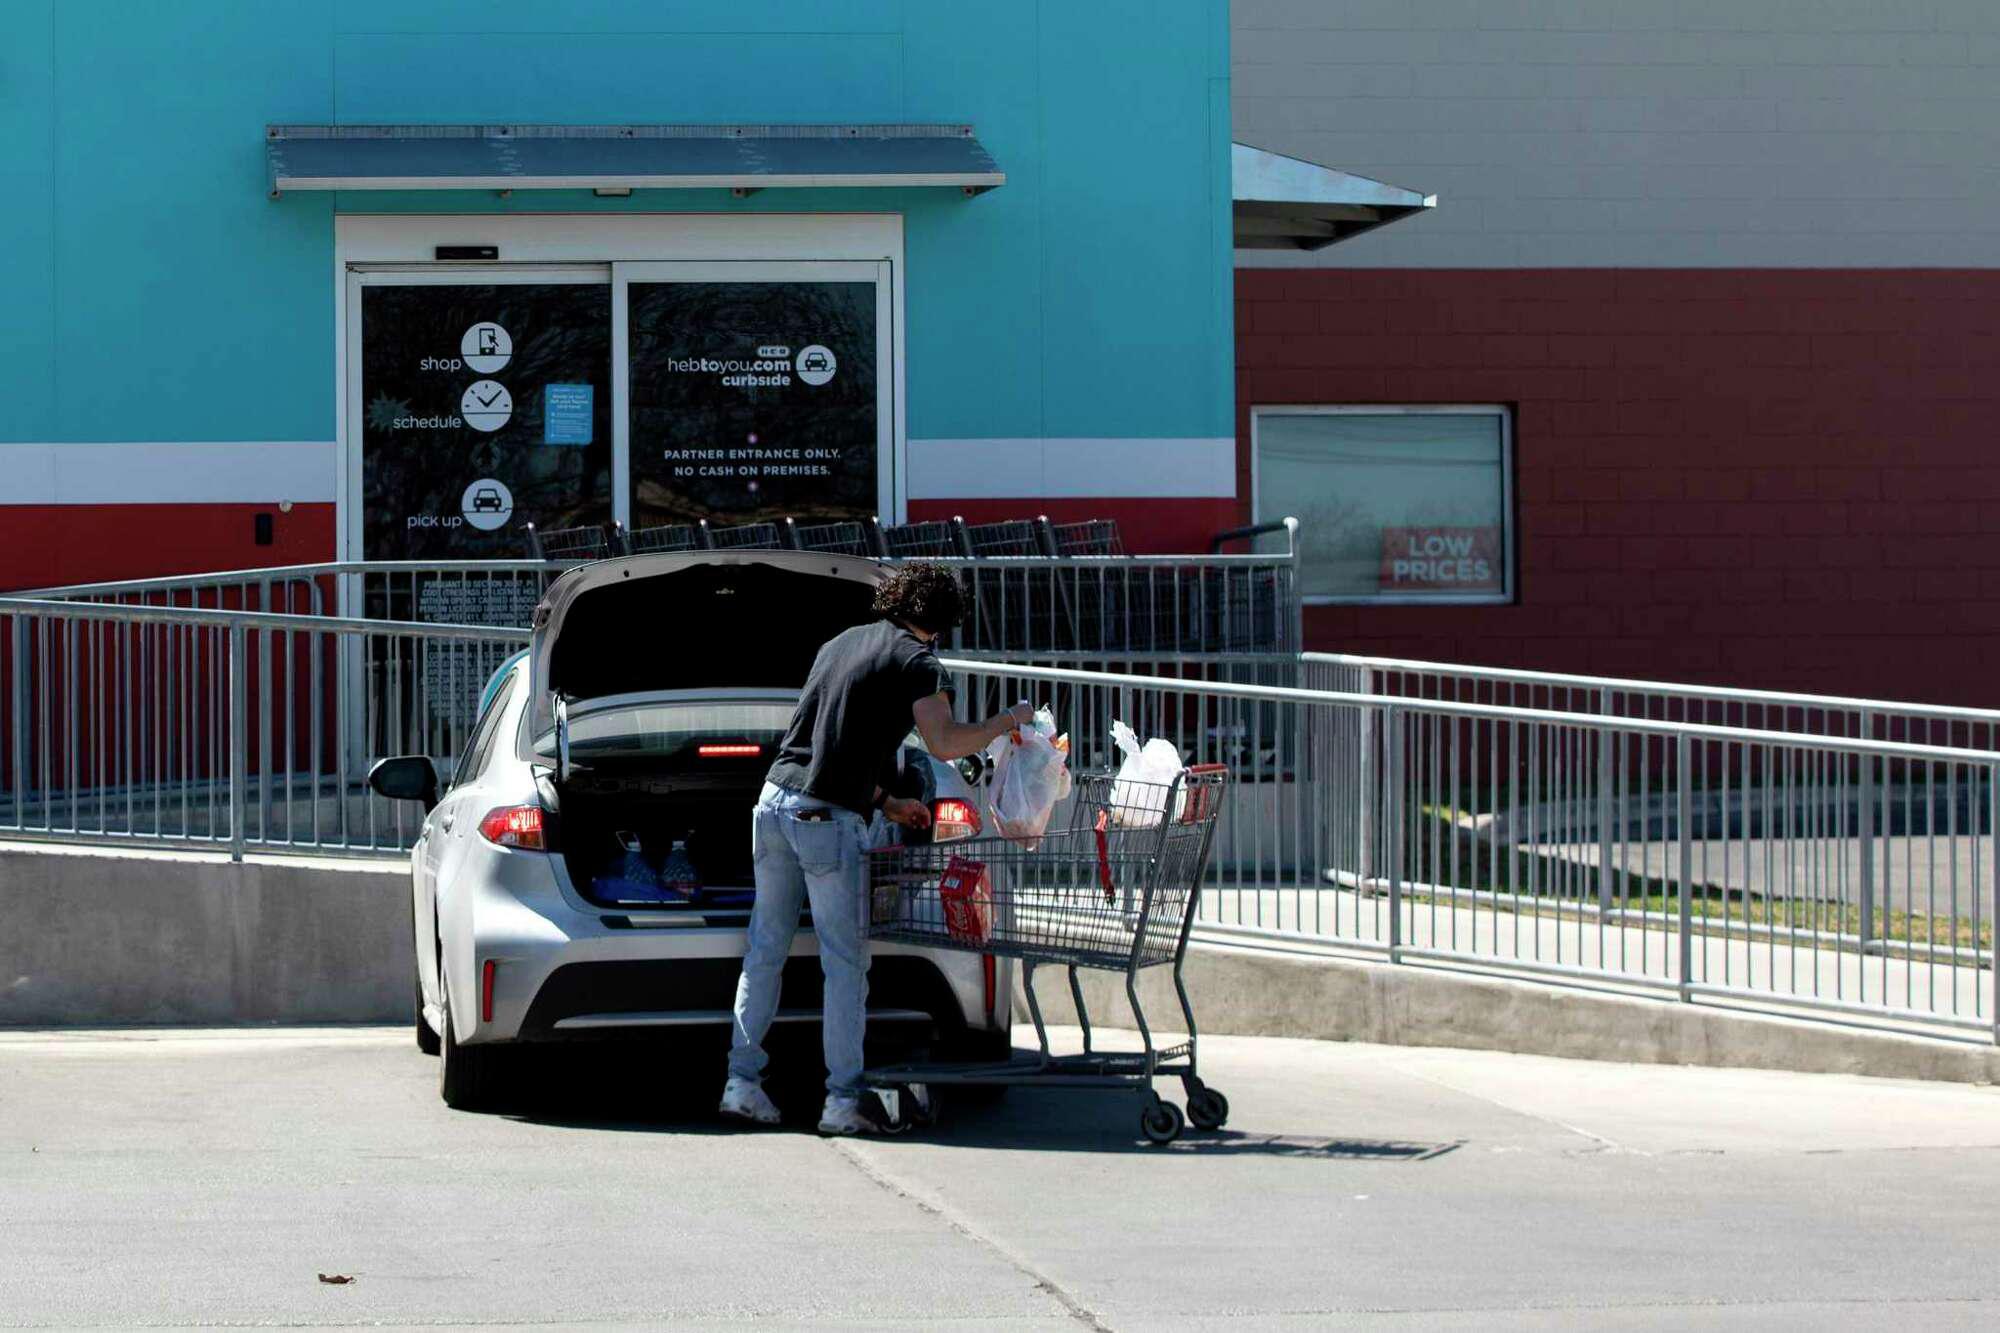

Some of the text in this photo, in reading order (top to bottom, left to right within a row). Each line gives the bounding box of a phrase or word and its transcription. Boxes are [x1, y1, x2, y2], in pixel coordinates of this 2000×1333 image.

[420, 357, 462, 372] shop
[668, 358, 791, 374] hebtoyou.com
[722, 374, 791, 386] curbside
[393, 415, 462, 429] schedule
[664, 449, 841, 459] PARTNER ENTRANCE ONLY.
[675, 466, 831, 476] NO CASH ON PREMISES.
[407, 514, 462, 529] pick up
[1408, 536, 1474, 556] LOW
[1393, 559, 1489, 581] PRICES
